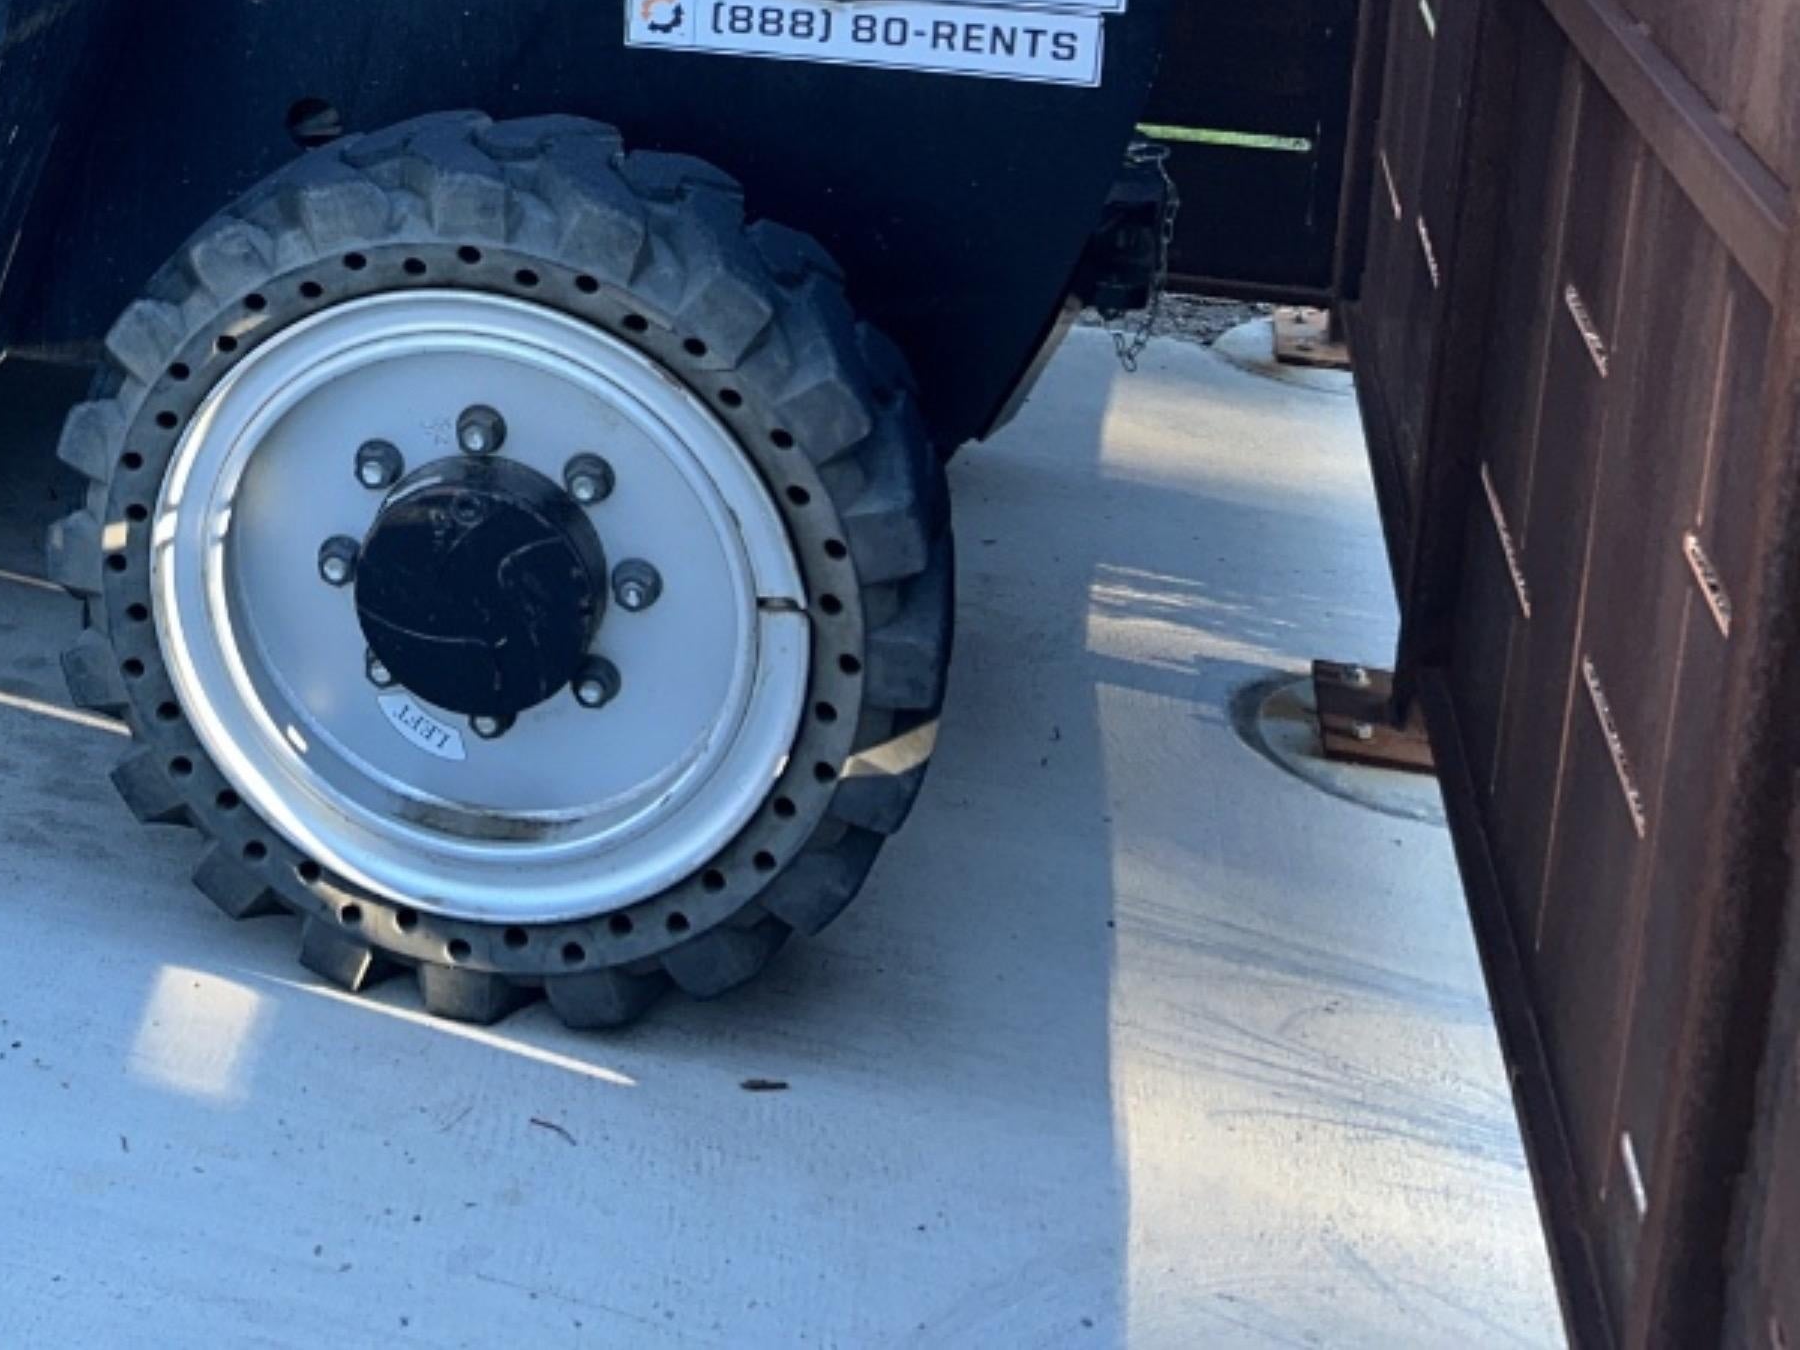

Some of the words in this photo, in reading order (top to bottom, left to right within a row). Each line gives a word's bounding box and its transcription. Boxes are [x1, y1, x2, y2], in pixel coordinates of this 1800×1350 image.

[711, 3, 833, 43] (888)
[850, 13, 1080, 63] 80-RENTS
[393, 704, 452, 750] LEFT
